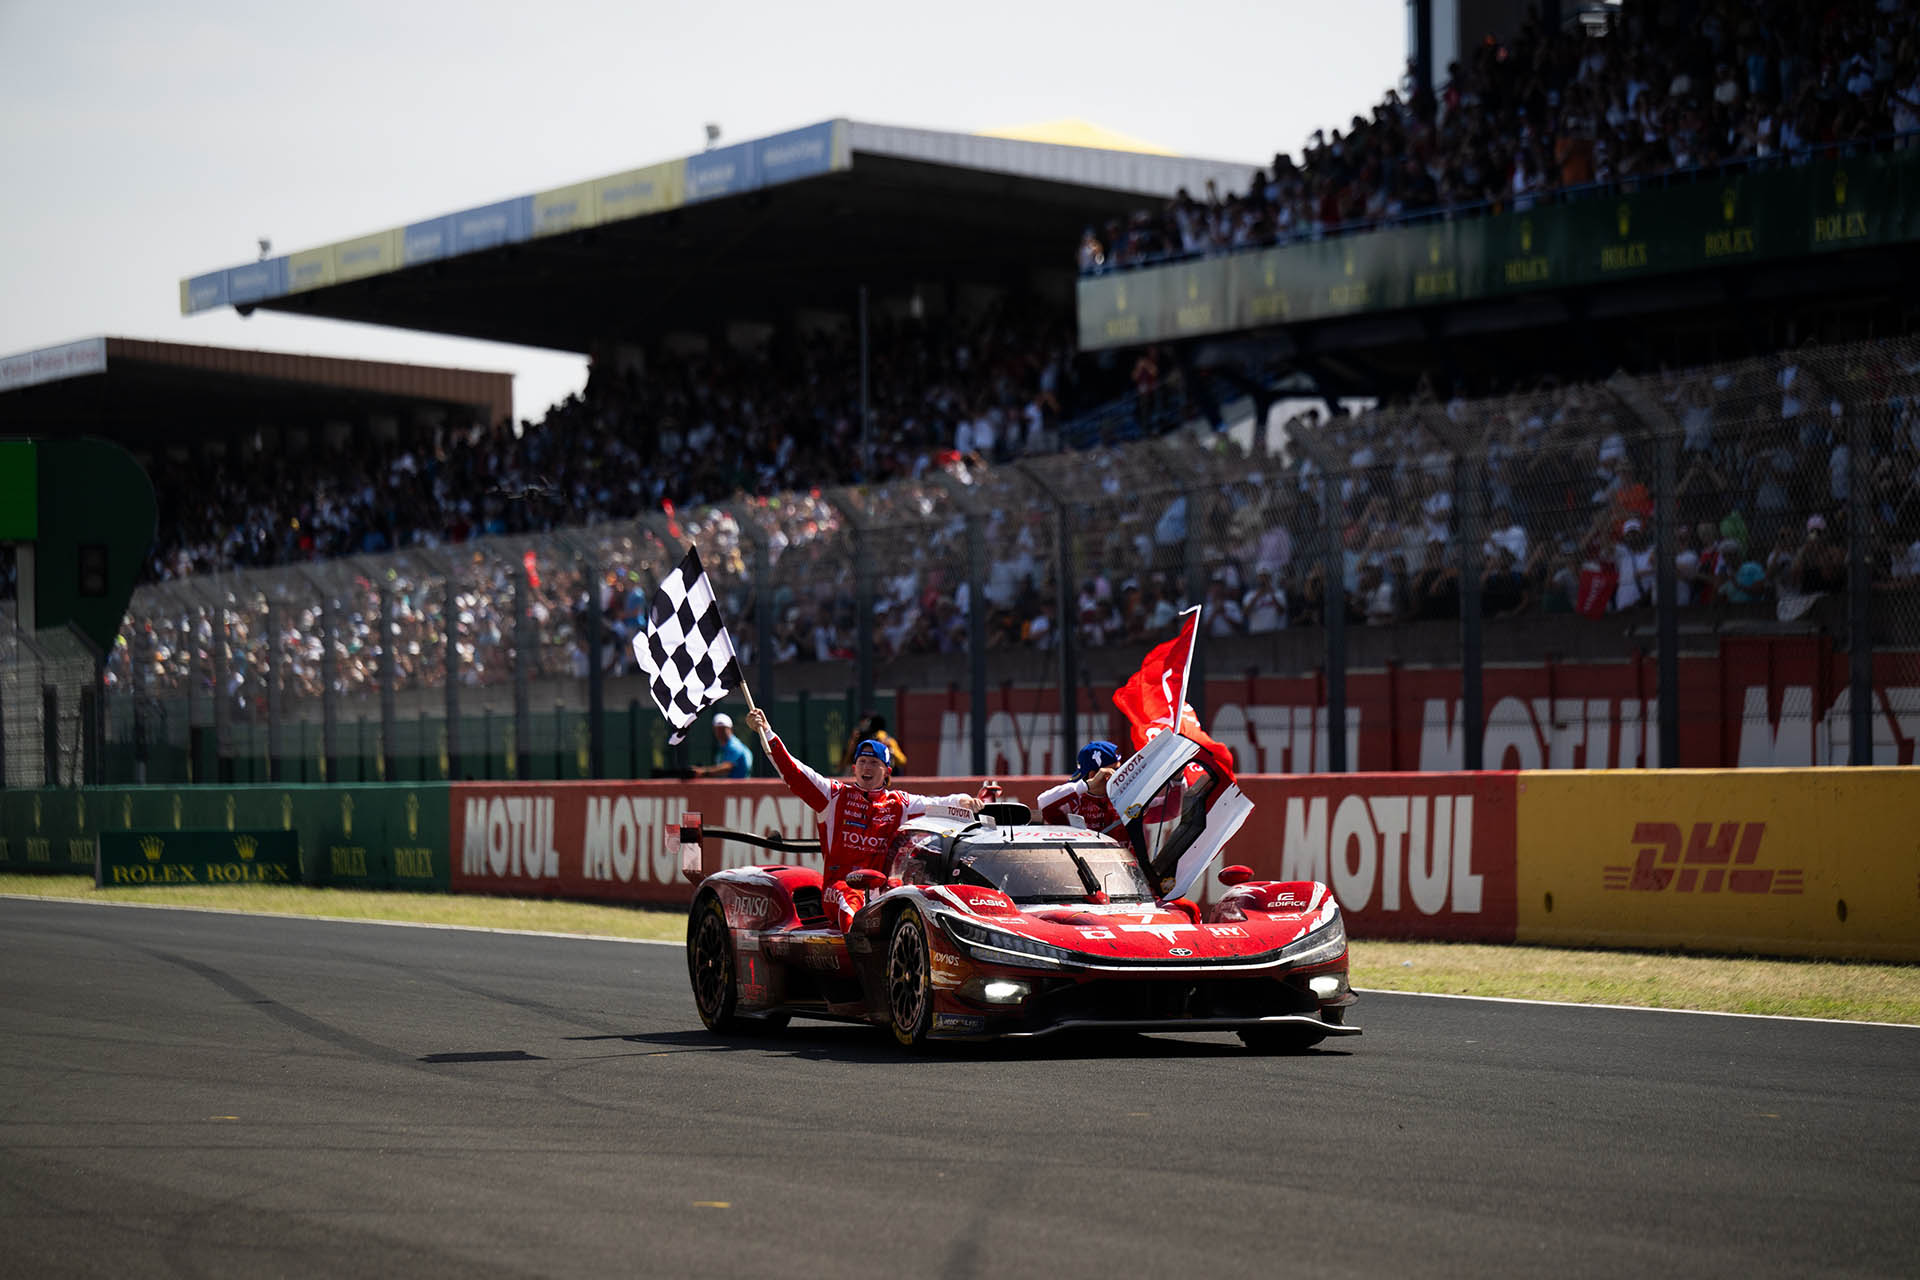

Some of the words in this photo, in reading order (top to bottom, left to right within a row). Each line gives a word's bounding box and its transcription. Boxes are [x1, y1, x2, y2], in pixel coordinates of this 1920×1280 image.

[1815, 212, 1867, 240] ROLEX
[1705, 228, 1753, 255] ROLEX
[1601, 243, 1647, 271] ROLEX
[1113, 755, 1144, 787] TOYOTA
[948, 806, 970, 819] TOYOTA
[463, 796, 559, 877] MOTUL
[842, 831, 888, 848] TOYOTA
[329, 847, 366, 876] ROLEX
[393, 848, 432, 877] ROLEX
[1280, 794, 1484, 915] MOTUL
[1629, 822, 1774, 894] DHL
[112, 864, 195, 882] ROLEX
[206, 863, 288, 882] ROLEX
[733, 896, 769, 916] DENSO
[969, 896, 1007, 907] CASIO
[1127, 914, 1153, 924] 7
[1208, 927, 1240, 936] HY
